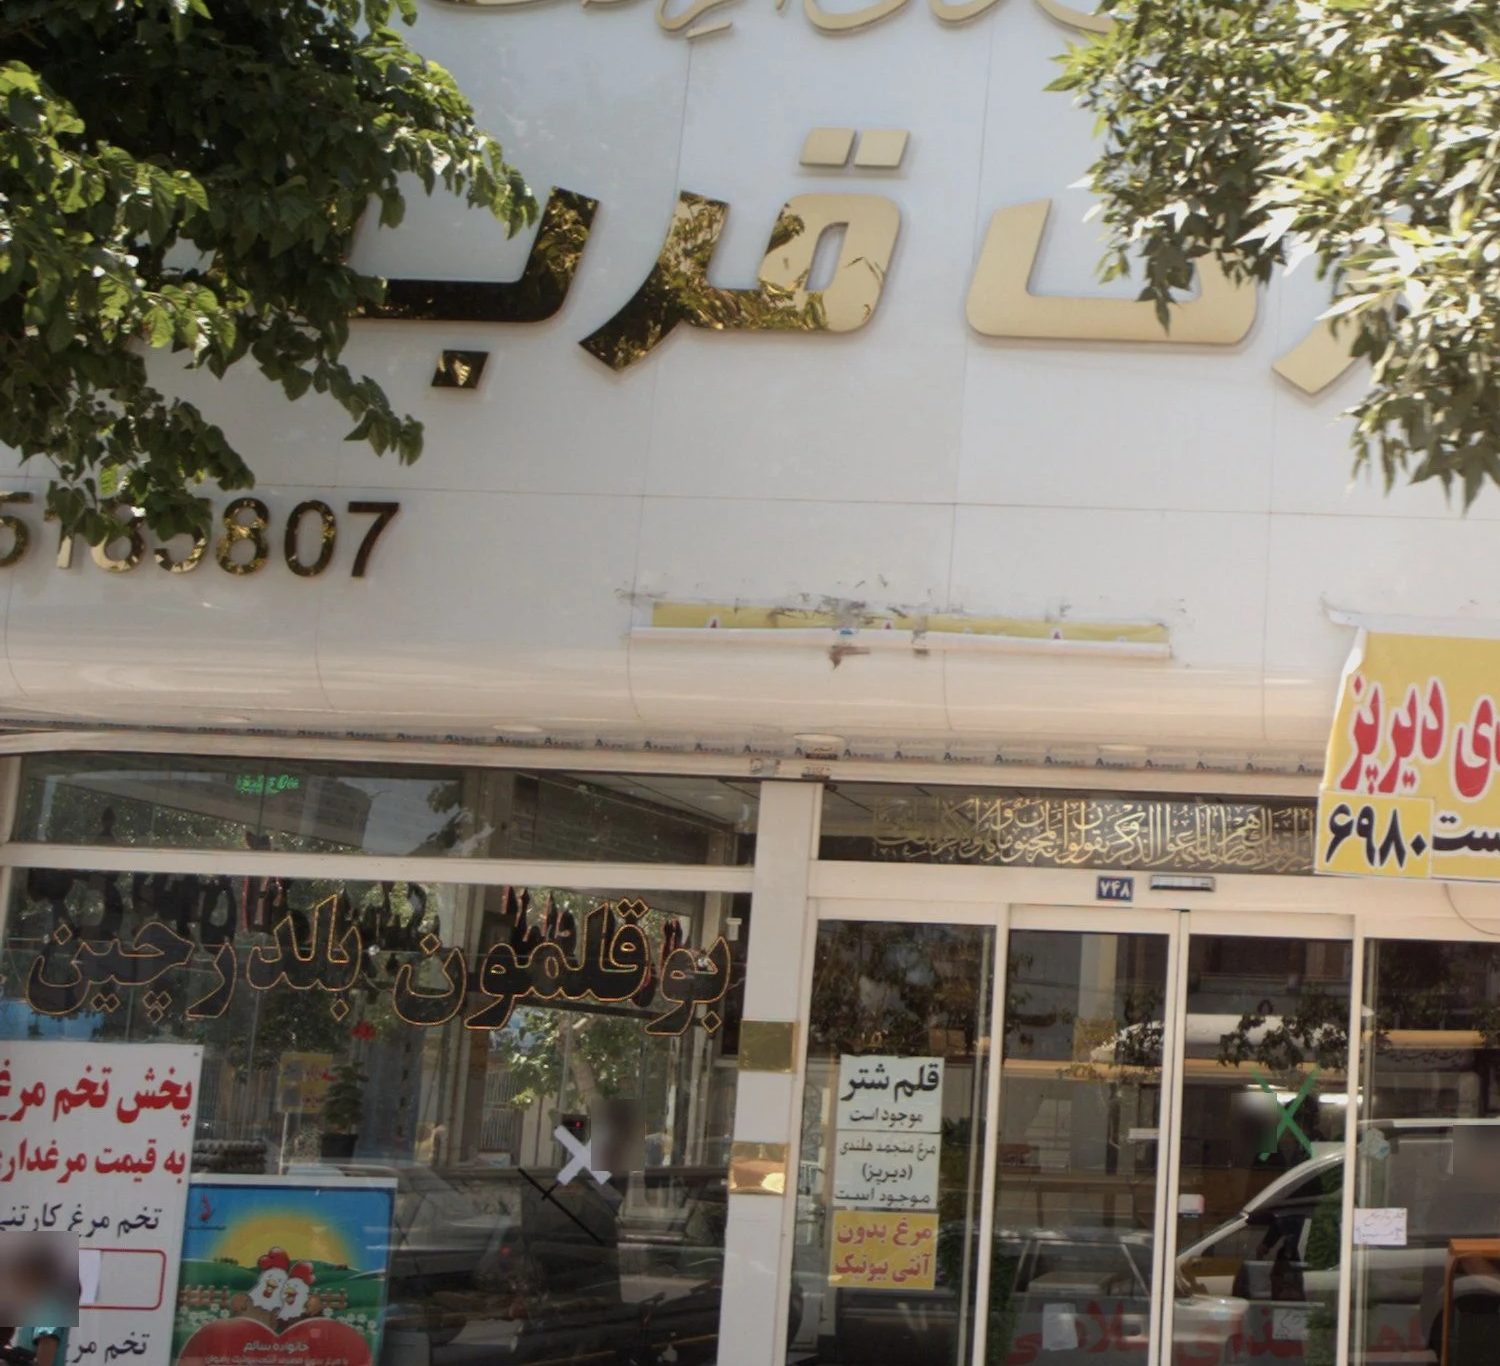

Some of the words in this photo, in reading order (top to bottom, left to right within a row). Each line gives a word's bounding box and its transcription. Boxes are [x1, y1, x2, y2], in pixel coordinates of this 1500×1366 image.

[1099, 878, 1132, 899] ۷۴۸
[25, 895, 364, 1023] بلدرچین
[392, 897, 731, 1036] بوقلمون
[53, 1065, 112, 1122] تخم
[116, 1066, 192, 1127] پخش
[840, 1063, 890, 1101] شتر
[894, 1063, 939, 1102] قلم
[850, 1107, 879, 1122] است
[881, 1109, 923, 1128] موجود
[95, 1138, 157, 1183] قیمت
[163, 1149, 186, 1184] به
[835, 1187, 875, 1202] است
[880, 1192, 931, 1208] موجود
[117, 1206, 162, 1239] تخم
[837, 1223, 887, 1244] بدون
[892, 1216, 932, 1246] مرغ
[66, 1341, 97, 1363] مر
[104, 1332, 151, 1363] تخم
